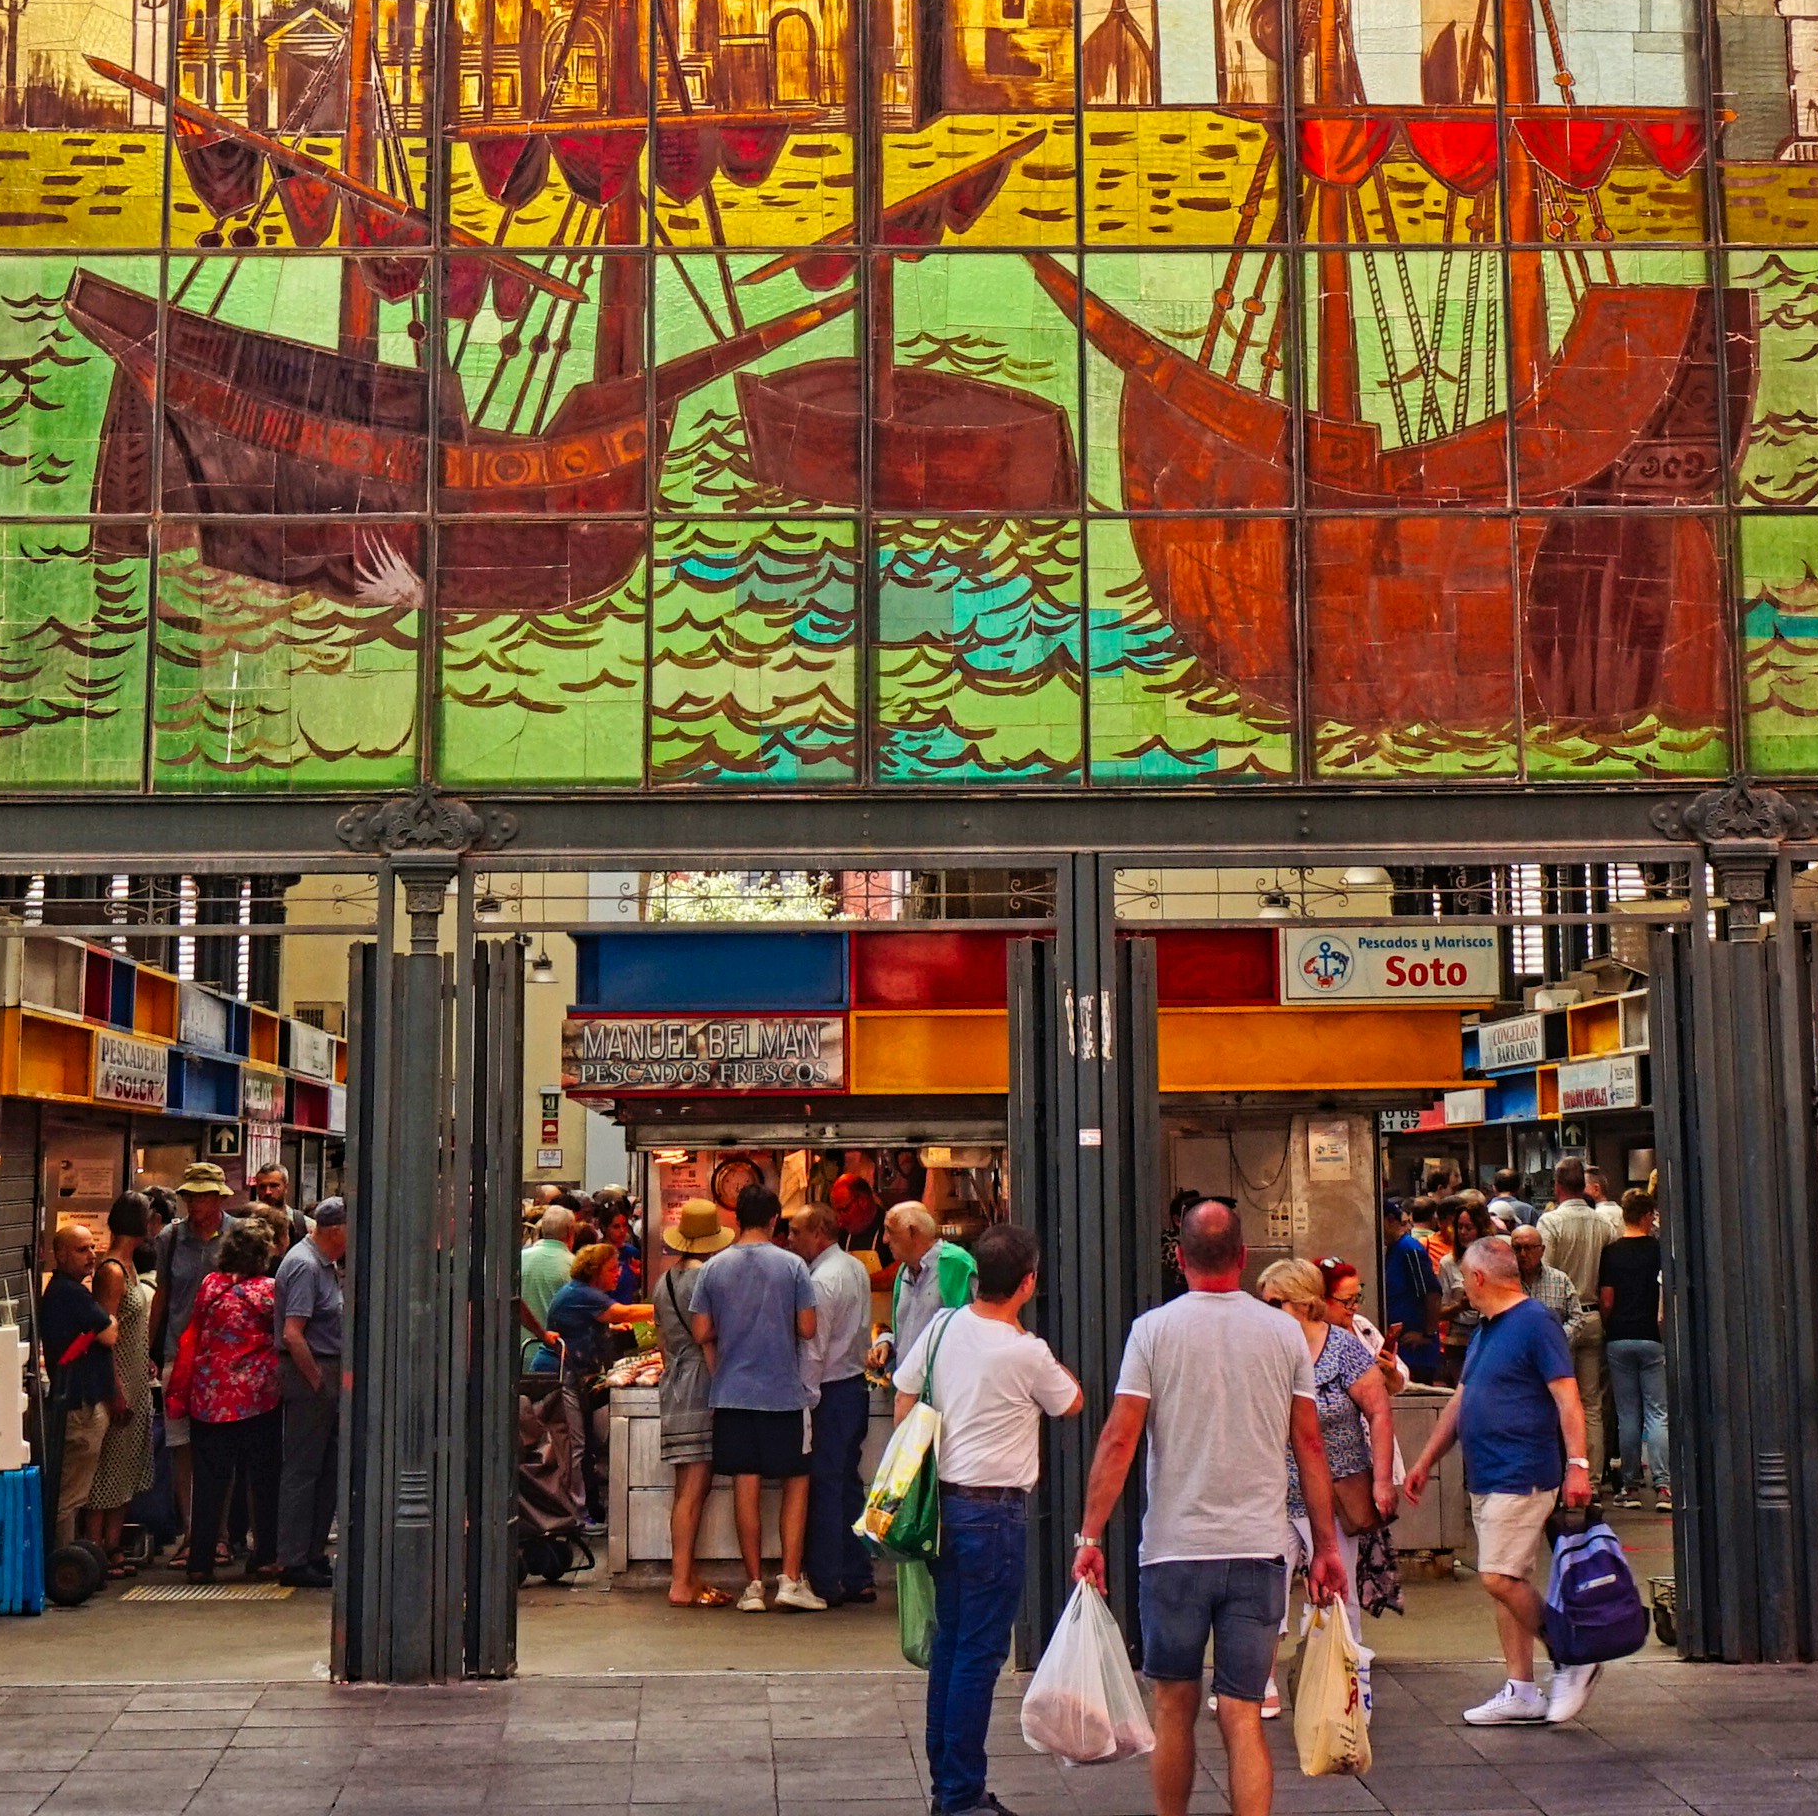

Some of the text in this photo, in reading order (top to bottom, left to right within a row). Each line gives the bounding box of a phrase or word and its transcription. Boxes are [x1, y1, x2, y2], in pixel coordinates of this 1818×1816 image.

[1358, 934, 1494, 951] Pescados y Mariscos
[1385, 955, 1468, 987] Soto
[583, 1024, 821, 1060] MANUEL BELMAN
[581, 1062, 829, 1084] PESCADOS FRESCOS
